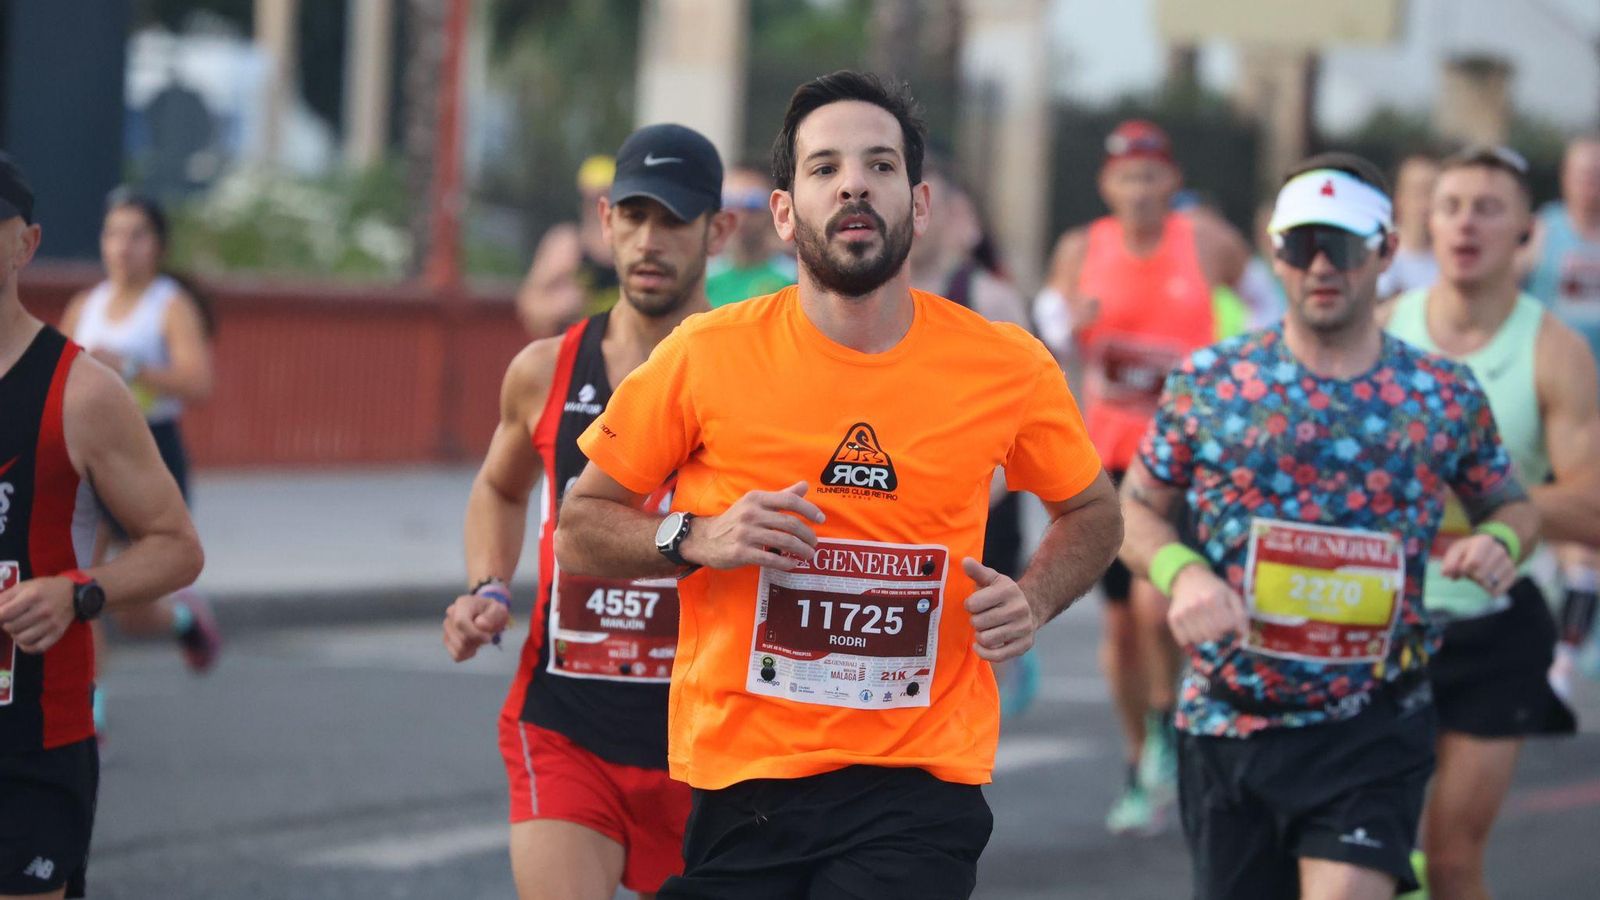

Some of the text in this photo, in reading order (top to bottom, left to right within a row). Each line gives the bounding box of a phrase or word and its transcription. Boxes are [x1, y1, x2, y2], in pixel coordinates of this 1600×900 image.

[851, 488, 871, 496] CLUB
[871, 491, 898, 501] RETIRO
[1288, 574, 1363, 606] 2270
[586, 588, 660, 618] 4557
[797, 599, 904, 635] 11725
[829, 634, 867, 648] RODRI
[881, 671, 907, 680] 21K
